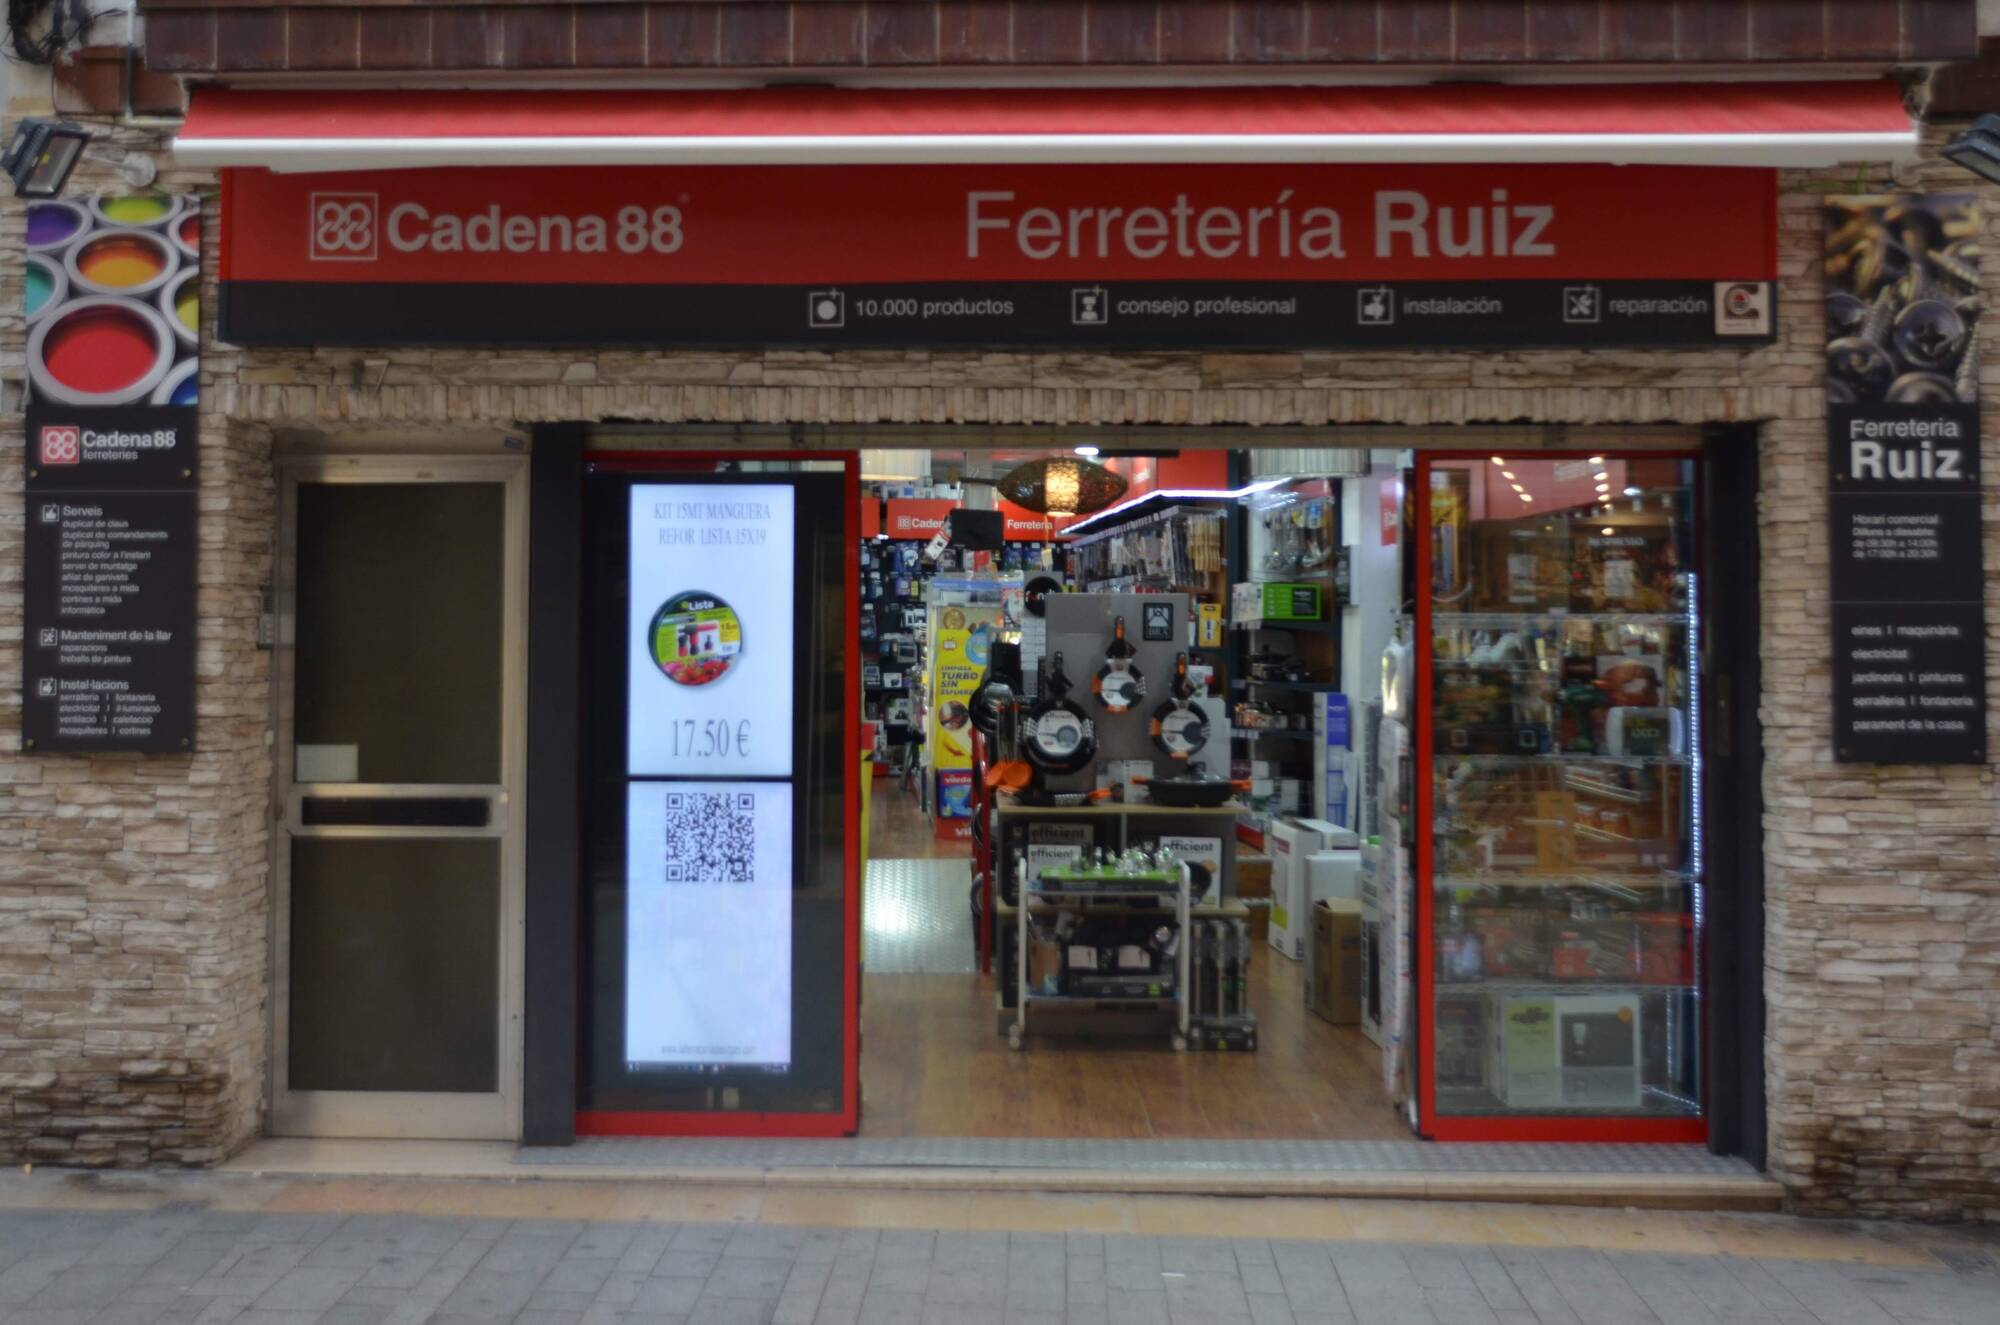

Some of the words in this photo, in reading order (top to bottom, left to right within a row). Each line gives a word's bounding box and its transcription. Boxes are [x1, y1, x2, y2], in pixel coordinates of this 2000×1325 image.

[387, 201, 607, 253] Cadena
[615, 205, 684, 255] 88
[967, 189, 1346, 259] Ferretería
[1374, 188, 1556, 258] Ruiz
[856, 298, 918, 317] 10.000
[923, 297, 1014, 323] productos
[1117, 297, 1189, 321] consejo
[1194, 296, 1296, 321] profesional
[1403, 296, 1502, 315] instalación
[1609, 297, 1708, 320] reparación
[82, 449, 138, 460] ferreteries
[1850, 440, 1961, 480] Ruiz
[63, 505, 103, 517] Serveis
[654, 503, 673, 520] KIT
[706, 502, 771, 520] MANGUERA
[96, 519, 106, 528] de
[95, 530, 106, 540] de
[659, 528, 695, 545] REFOR
[700, 528, 732, 545] LISTA
[62, 540, 74, 549] de
[62, 551, 90, 562] pintura
[91, 551, 111, 560] color
[88, 562, 99, 572] de
[689, 599, 714, 611] Lista
[60, 629, 128, 641] Manteniment
[129, 629, 143, 641] de
[145, 629, 155, 641] la
[91, 655, 102, 664] de
[104, 655, 132, 666] pintura
[941, 672, 978, 681] TURBO
[941, 680, 959, 689] SIN
[1907, 719, 1922, 731] de
[671, 719, 730, 758] 17.50
[735, 719, 751, 758] €
